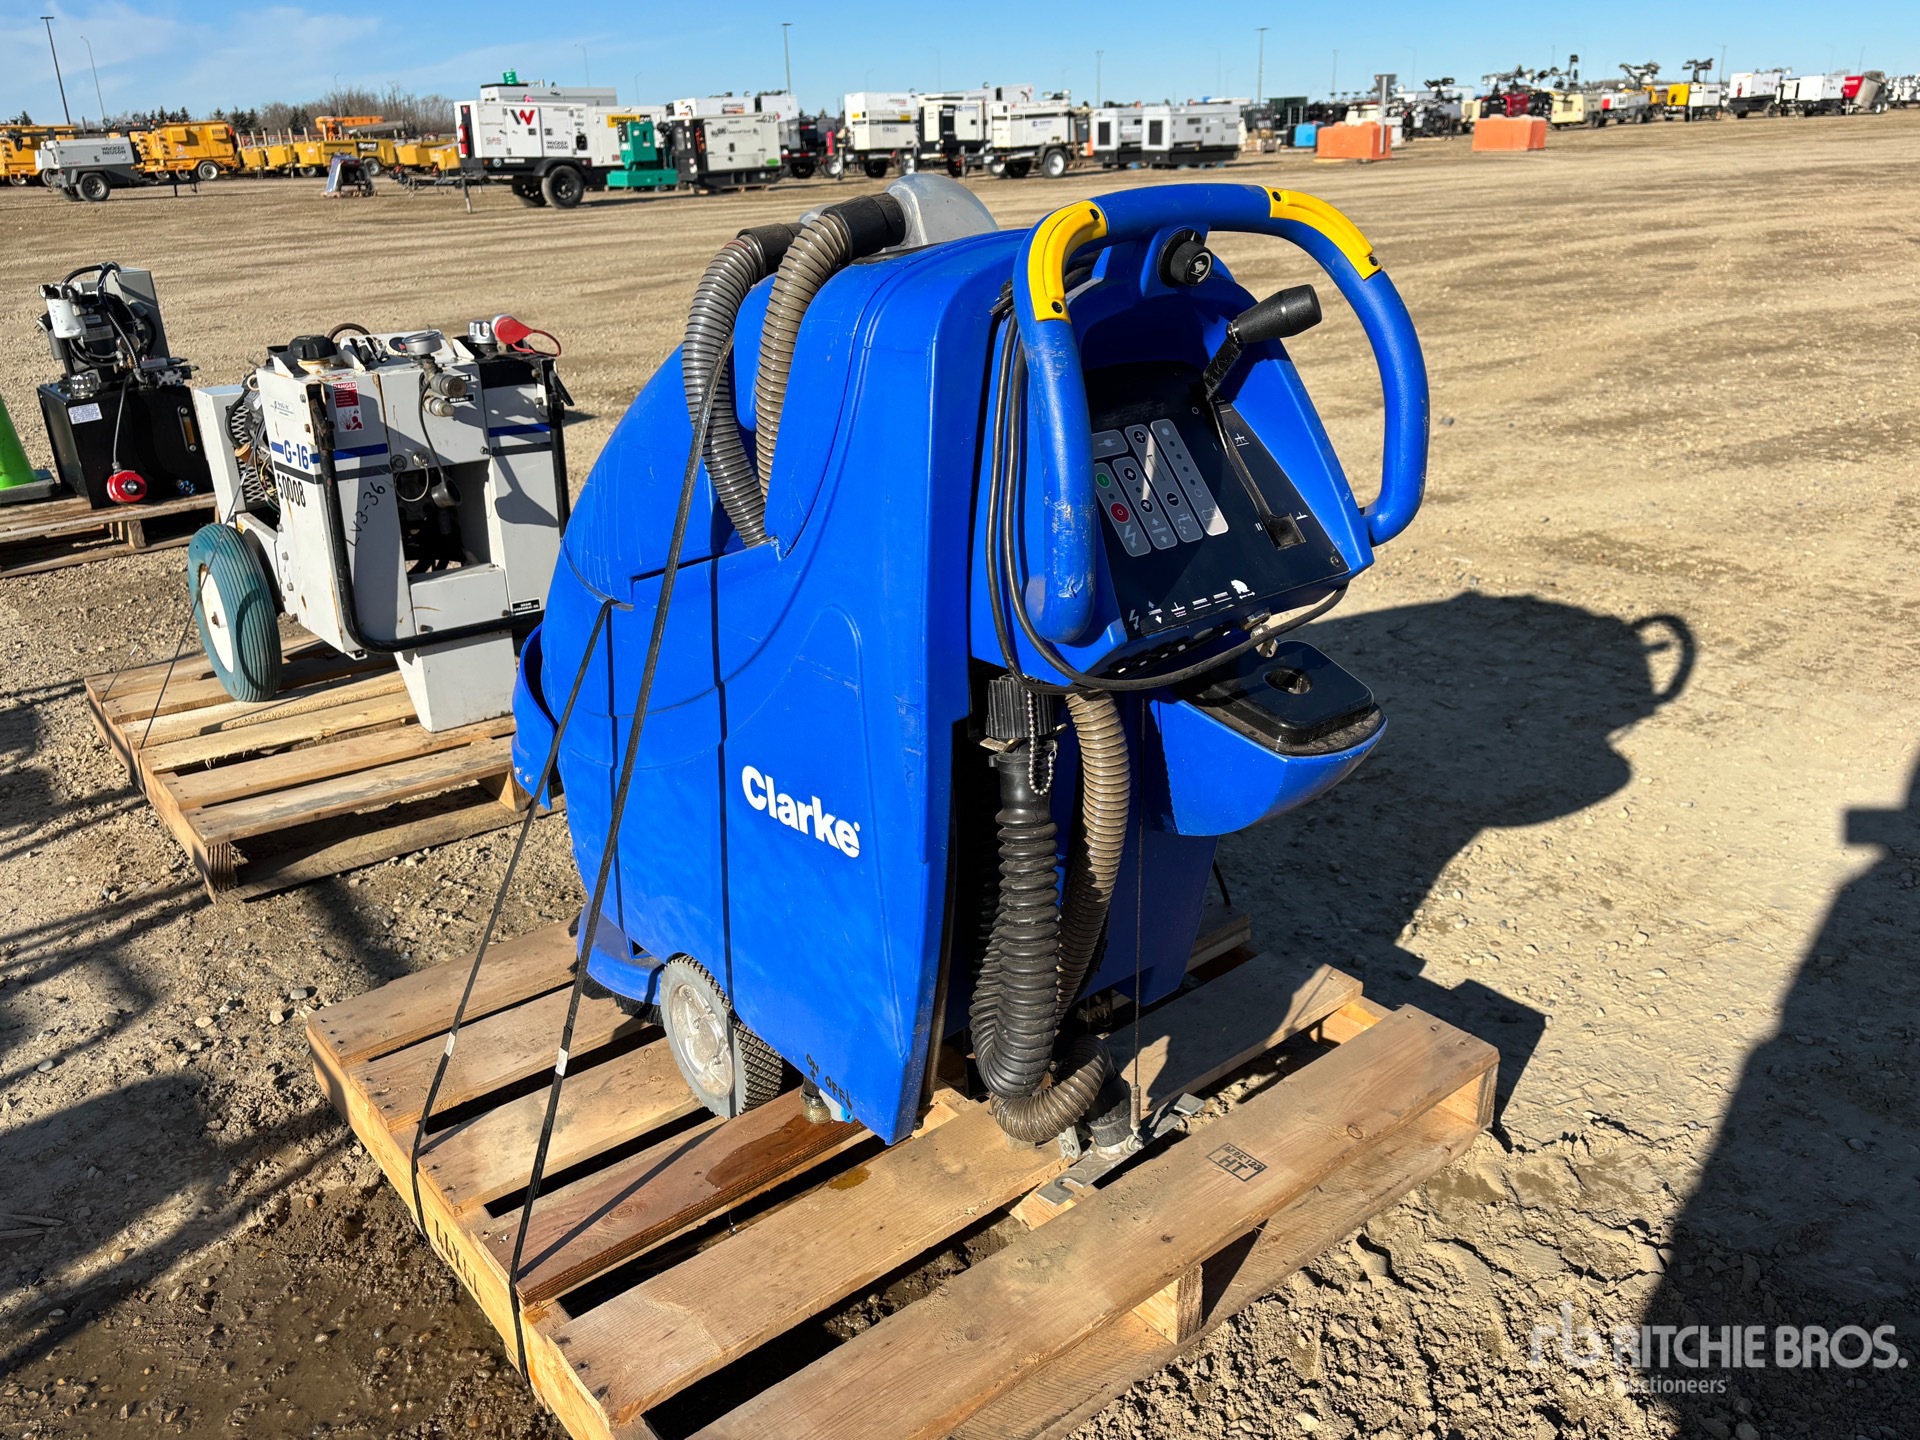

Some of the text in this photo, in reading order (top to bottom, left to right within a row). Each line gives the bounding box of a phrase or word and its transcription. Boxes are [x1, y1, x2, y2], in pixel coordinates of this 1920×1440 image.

[283, 439, 309, 470] G-16
[277, 473, 306, 508] 50008
[741, 765, 860, 858] Clarke
[1218, 1155, 1249, 1173] HT
[1245, 1159, 1263, 1171] 123
